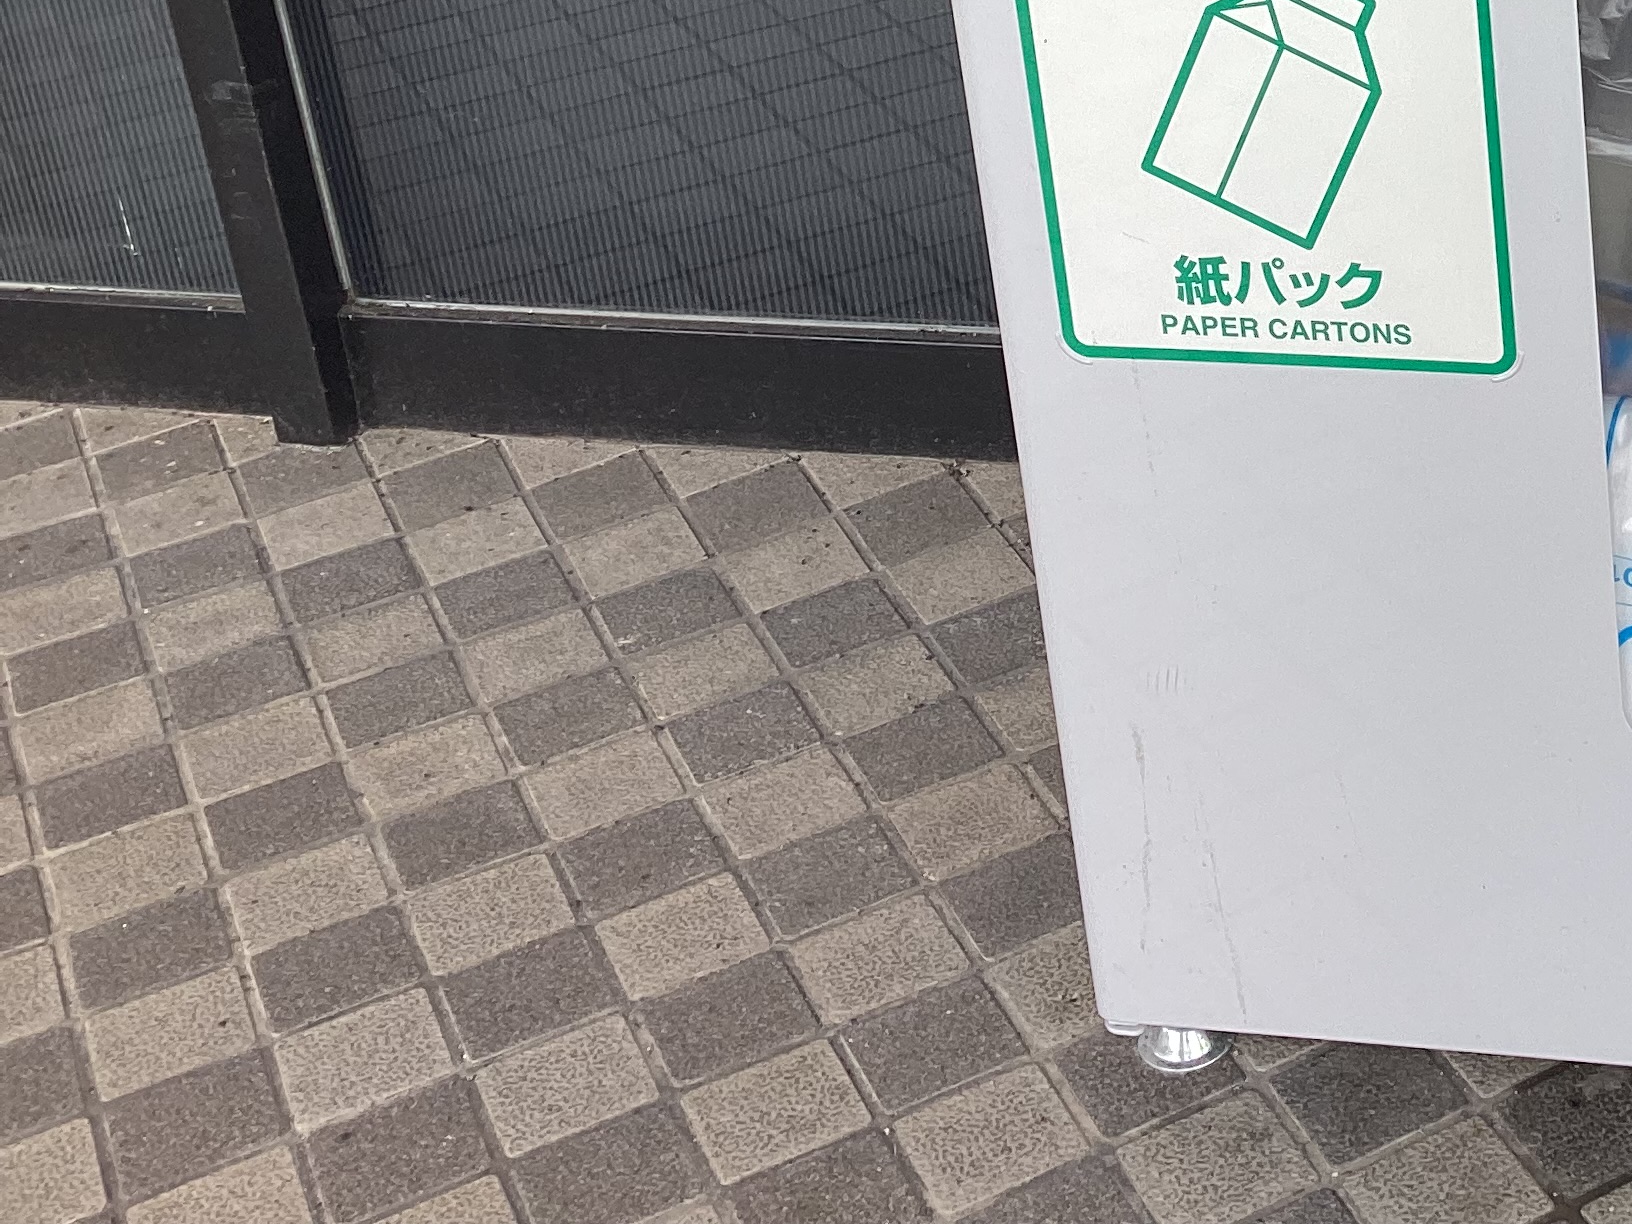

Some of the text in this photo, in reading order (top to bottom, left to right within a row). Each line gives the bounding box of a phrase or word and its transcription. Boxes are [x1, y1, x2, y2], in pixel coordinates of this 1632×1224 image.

[1174, 254, 1383, 309] 紙パック
[1161, 313, 1412, 345] PAPER CARTONS
